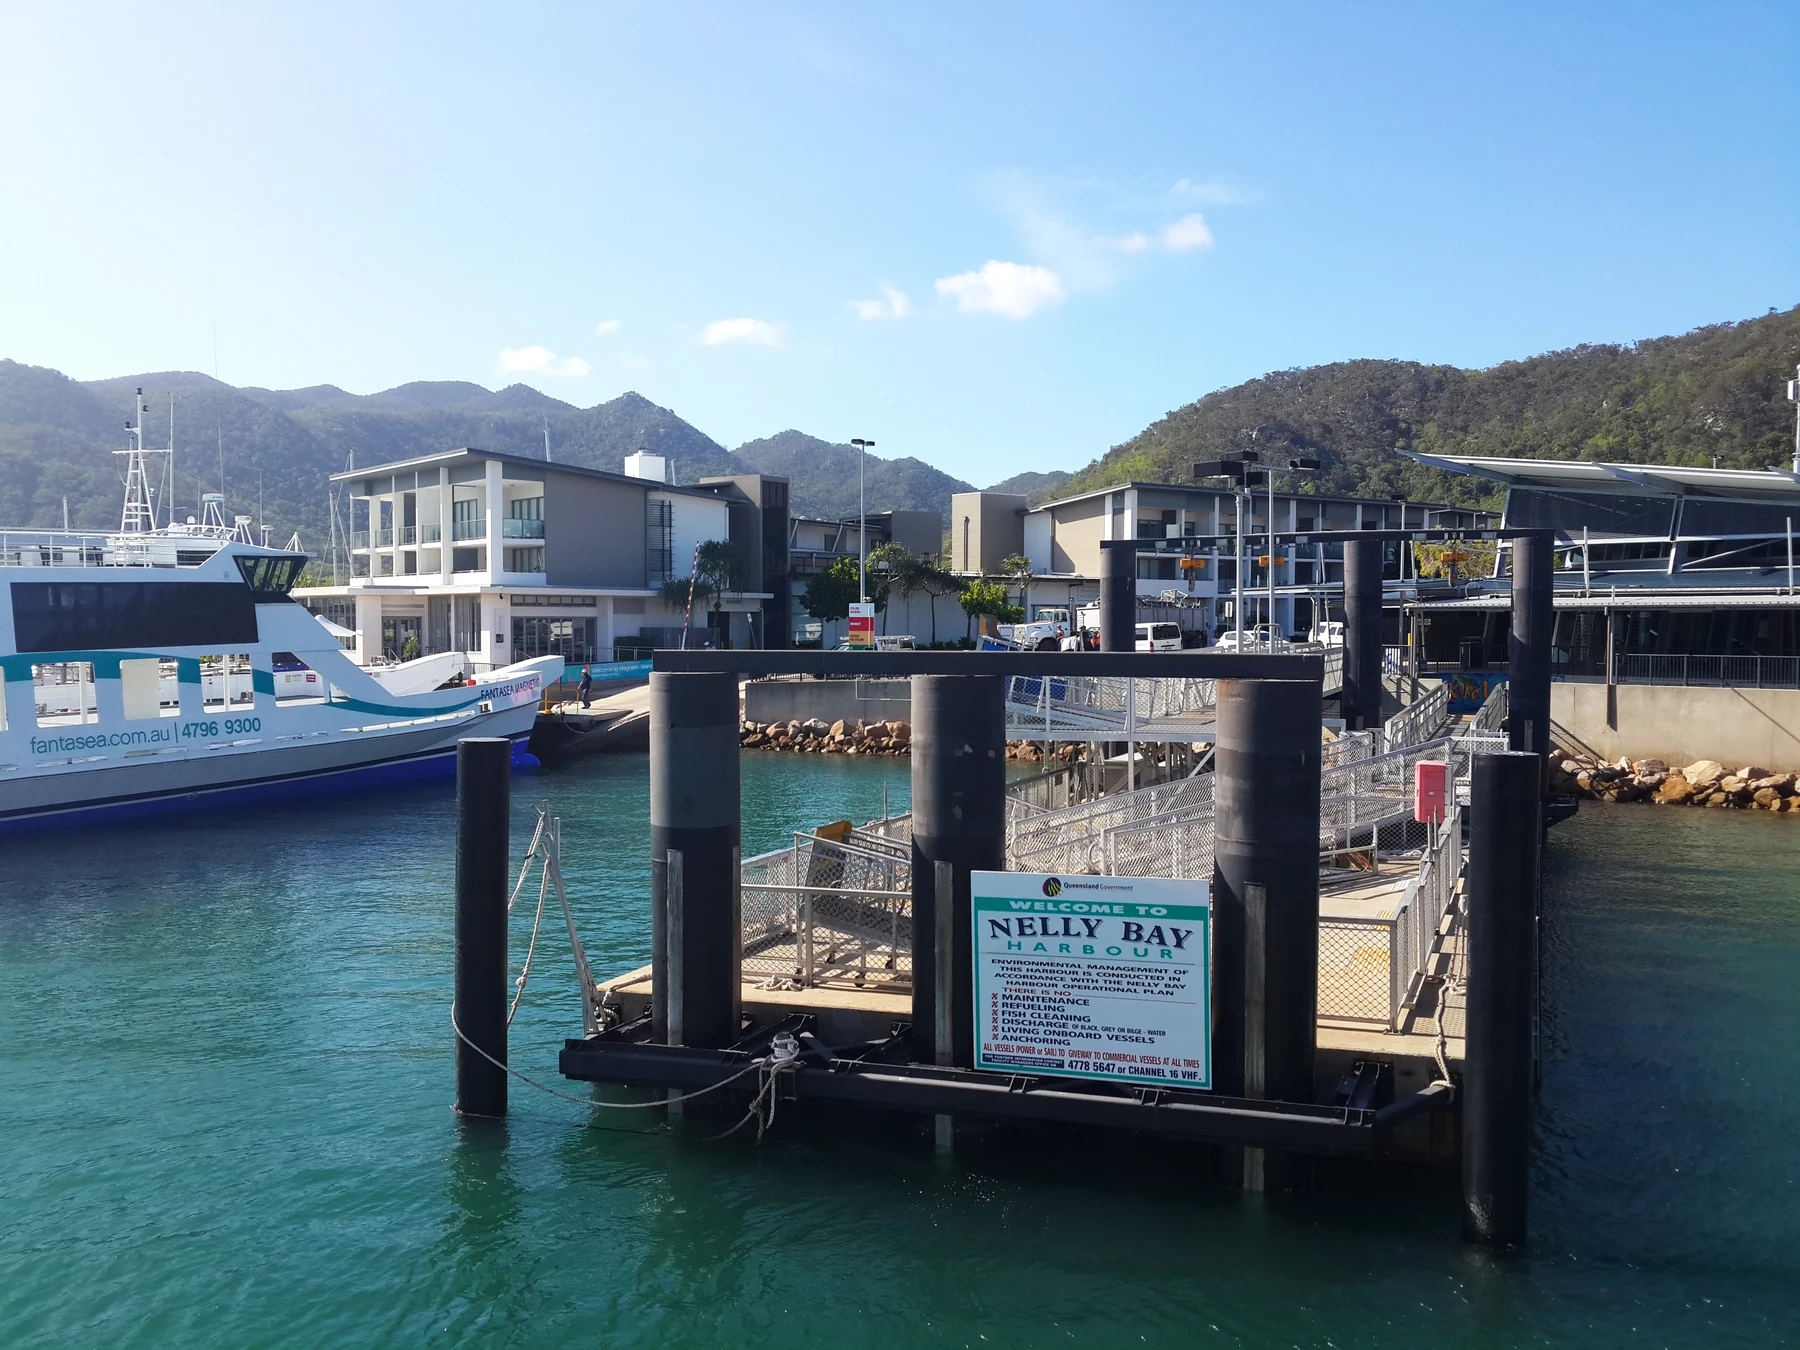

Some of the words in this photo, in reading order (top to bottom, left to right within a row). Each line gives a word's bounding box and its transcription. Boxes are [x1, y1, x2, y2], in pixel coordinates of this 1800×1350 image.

[619, 664, 640, 672] Magnetic
[480, 684, 514, 700] FANTASEA
[514, 678, 540, 694] MAGNETIC
[30, 729, 170, 754] fantasea.com.au
[182, 721, 218, 738] 4796
[225, 718, 261, 734] 9300
[1009, 901, 1124, 914] WELCOME
[1136, 906, 1168, 916] TO
[988, 917, 1102, 939] NELLY
[1121, 921, 1193, 950] BAY
[1007, 941, 1173, 959] HARBOUR
[992, 959, 1084, 969] ENVIRONMENTAL
[1087, 964, 1169, 974] MANAGEMENT
[994, 973, 1066, 982] ACCORDANCE
[1026, 968, 1079, 976] HARBOUR
[1096, 972, 1165, 981] CONDUCTED
[1062, 984, 1139, 994] OPERATIONAL
[1002, 994, 1090, 1006] MAINTENANCE
[1002, 1002, 1065, 1012] REFUELING
[1002, 1010, 1026, 1018] FISH
[1030, 1012, 1091, 1022] CLEANING
[1002, 1018, 1069, 1029] DISCHARGE
[1001, 1035, 1071, 1046] ANCHORING
[1002, 1026, 1040, 1035] LIVING
[1043, 1029, 1102, 1040] ONBOARD
[1106, 1034, 1155, 1044] VESSELS
[984, 1043, 992, 1051] ALL
[994, 1044, 1014, 1053] VESSELS
[1058, 1049, 1065, 1057] TO
[1068, 1050, 1092, 1059] GIVEWAY
[1102, 1052, 1137, 1063] COMMERCIAL
[1139, 1055, 1161, 1065] VESSELS
[1172, 1058, 1181, 1067] ALL
[1183, 1059, 1199, 1068] TIMES
[1068, 1060, 1090, 1071] 4778
[1093, 1062, 1116, 1072] 5647
[1128, 1066, 1166, 1077] CHANNEL
[1169, 1070, 1178, 1078] 16
[1181, 1071, 1201, 1080] VHF.
